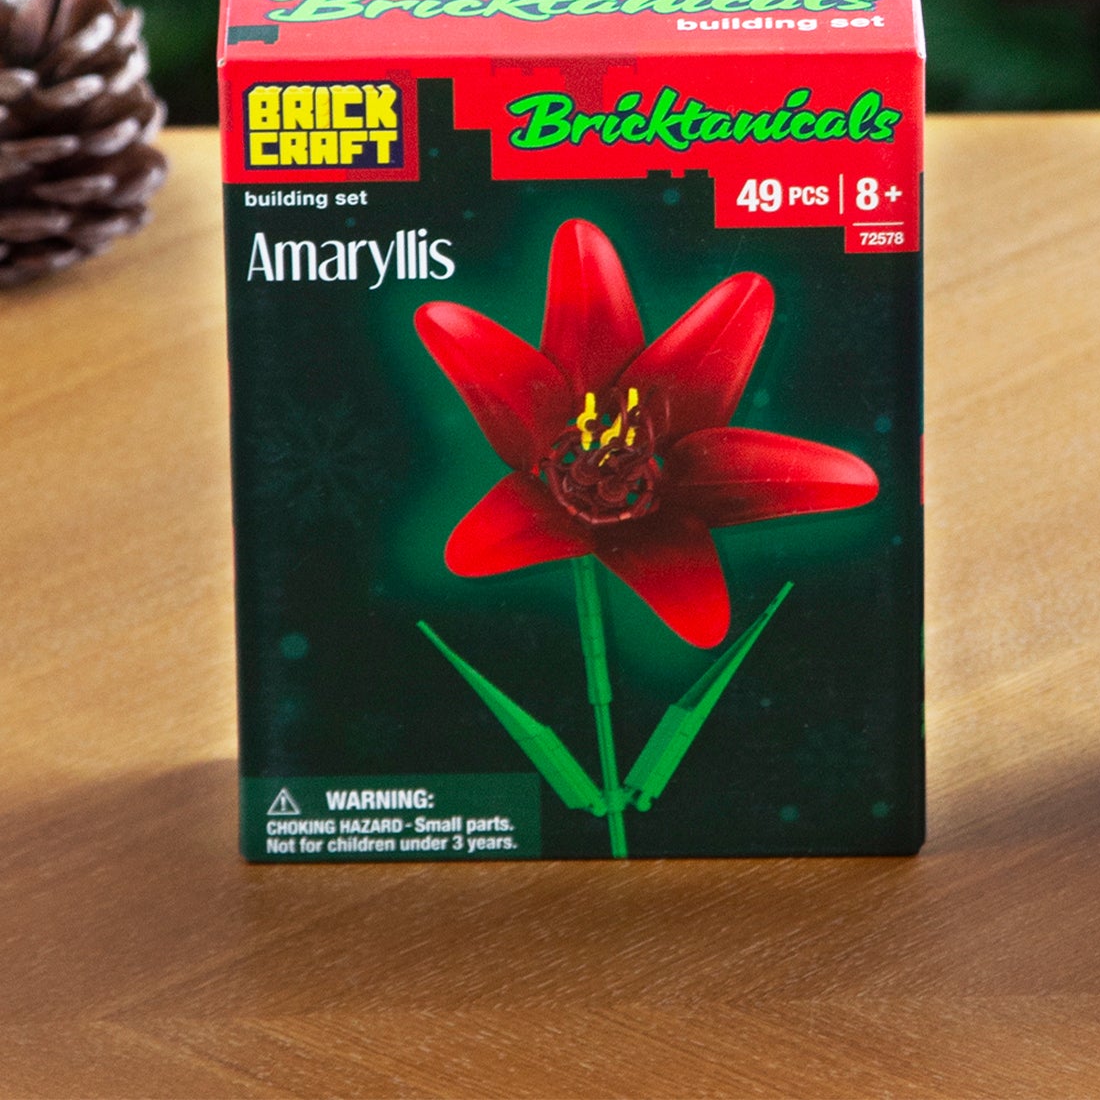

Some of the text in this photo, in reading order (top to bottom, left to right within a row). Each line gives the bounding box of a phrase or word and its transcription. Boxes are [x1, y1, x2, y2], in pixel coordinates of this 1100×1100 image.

[676, 15, 885, 31] building set
[248, 84, 398, 130] BRICK
[508, 86, 902, 151] Bricktanicals
[249, 130, 398, 166] CRAFT
[244, 190, 368, 209] building set
[736, 178, 830, 212] 49 PCS
[855, 177, 903, 211] 8+
[859, 231, 904, 246] 72578
[247, 227, 456, 290] Amaryllis
[326, 789, 435, 811] WARNING:
[266, 819, 337, 836] CHOKING
[340, 818, 404, 834] HAZARD
[414, 816, 463, 833] Small
[466, 816, 515, 835] parts.
[266, 835, 518, 854] Not for children under 3 years.
